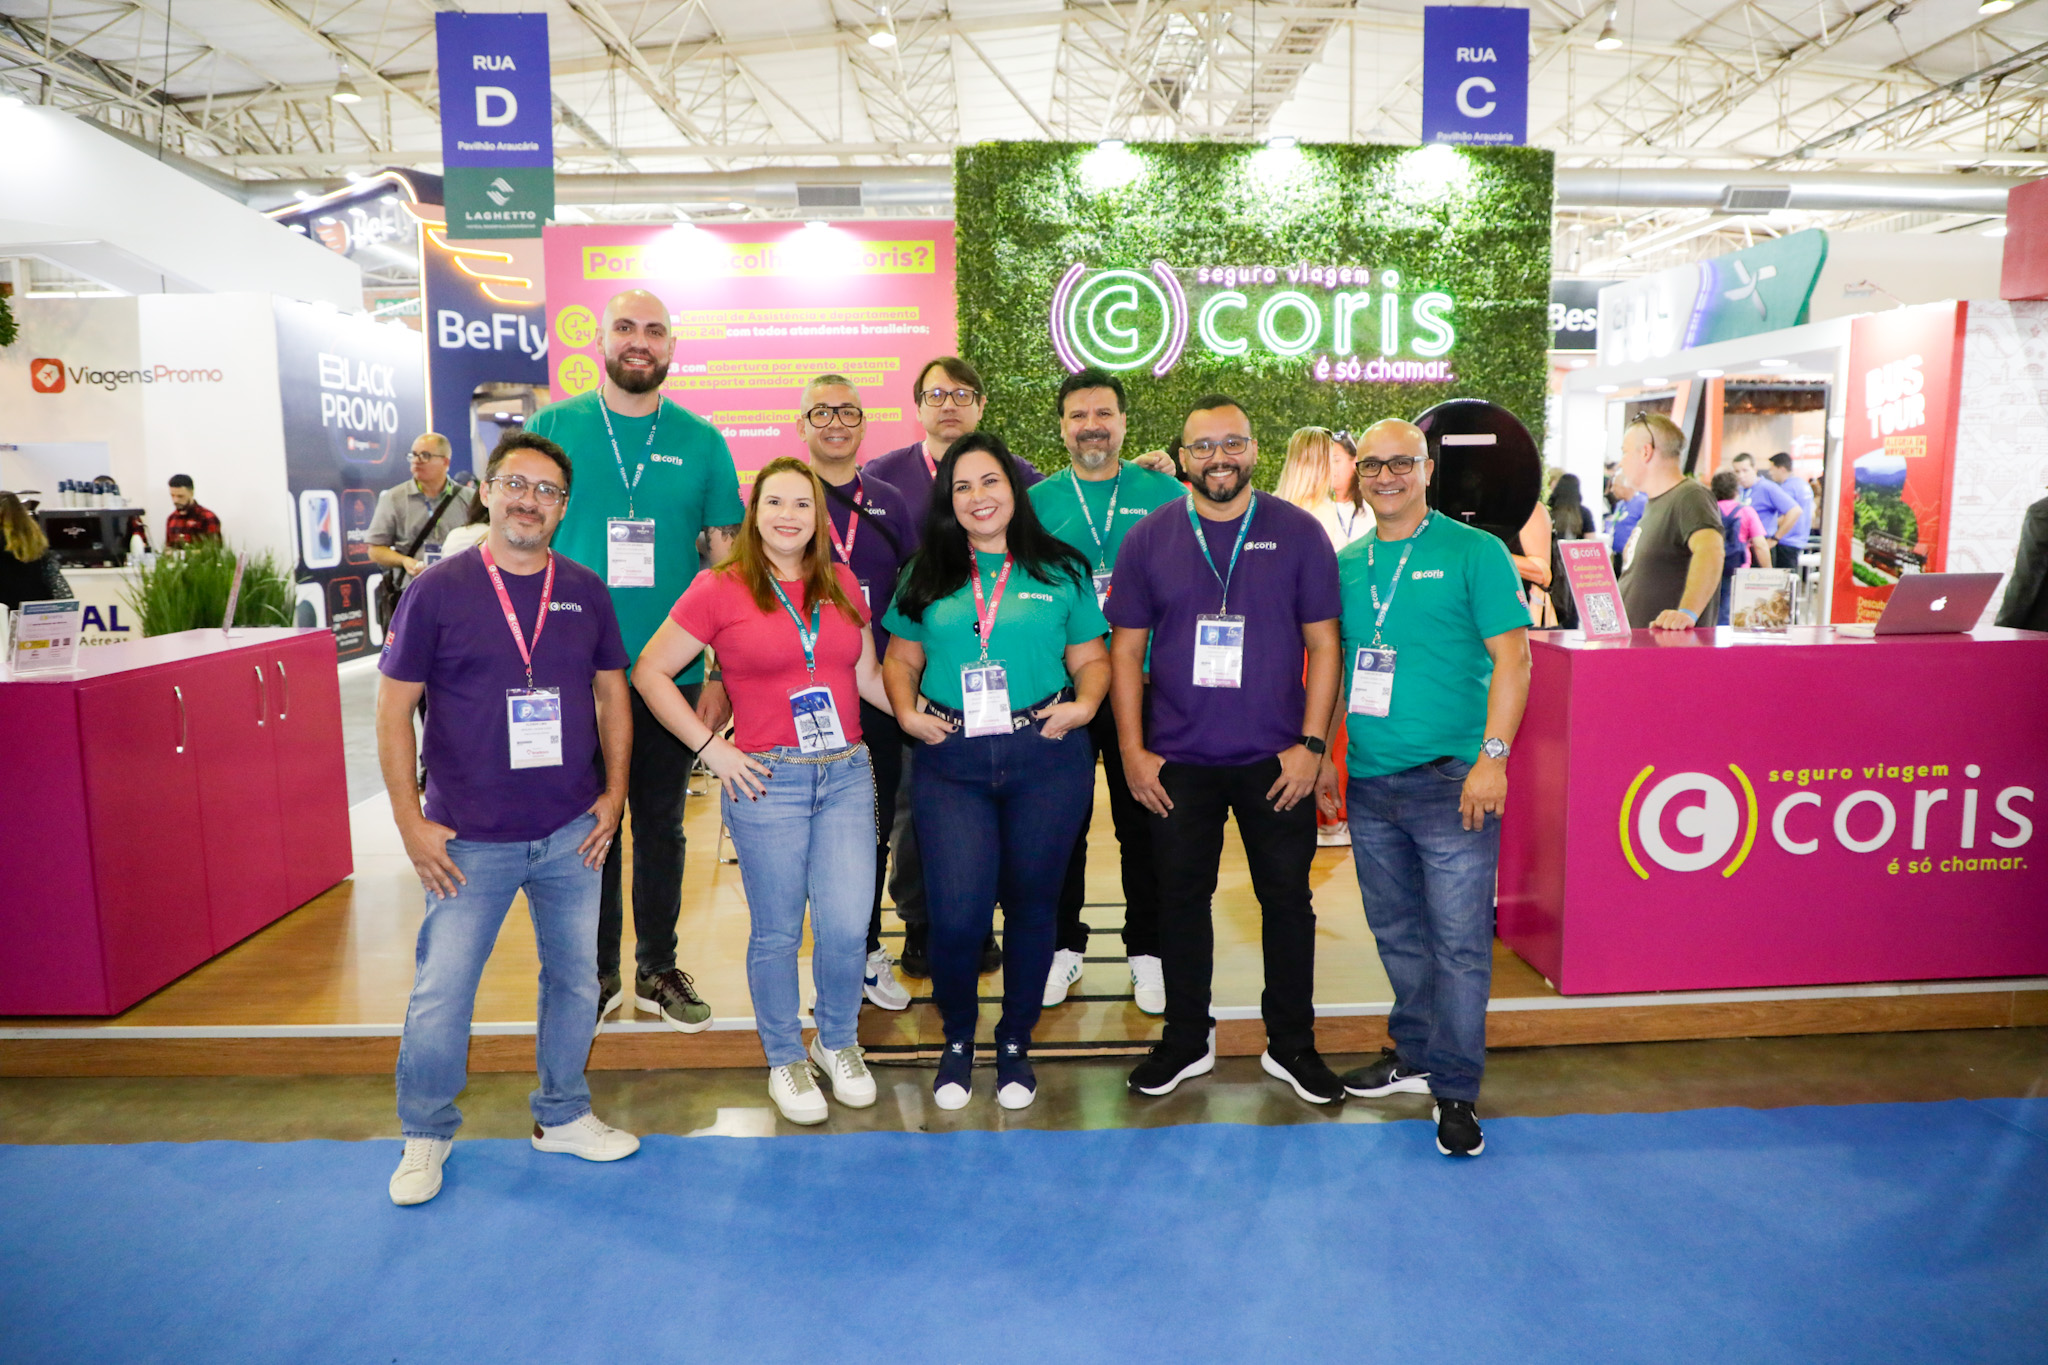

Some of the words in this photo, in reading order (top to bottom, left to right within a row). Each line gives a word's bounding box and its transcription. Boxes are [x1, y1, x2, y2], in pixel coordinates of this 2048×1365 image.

[1456, 47, 1498, 62] RUA
[472, 55, 517, 71] RUA
[1456, 76, 1497, 118] C
[475, 86, 518, 127] D
[1436, 131, 1473, 141] Pavilhão
[1473, 132, 1514, 141] Araucária
[457, 140, 496, 151] Pavilhão
[497, 141, 539, 151] Araucária
[465, 211, 536, 221] LAGHETTO
[589, 252, 636, 273] Por
[854, 246, 930, 267] oris?
[1198, 266, 1277, 289] seguro
[1287, 263, 1371, 290] viagem
[682, 312, 728, 323] Central
[731, 312, 745, 321] de
[748, 310, 817, 322] Assistência
[820, 312, 826, 320] e
[830, 308, 917, 321] departamento
[1198, 269, 1456, 357] coris
[437, 310, 548, 360] BeFly
[575, 330, 591, 341] 24
[700, 327, 724, 337] 24h
[726, 327, 751, 337] com
[752, 325, 788, 337] todos
[789, 324, 859, 336] atendentes
[861, 323, 930, 336] brasileiros;
[318, 352, 397, 398] BLACK
[681, 363, 707, 373] com
[709, 361, 769, 372] cobertura
[772, 362, 792, 373] por
[1316, 357, 1330, 378] é
[1335, 357, 1362, 379] só
[1366, 357, 1455, 379] chamar.
[68, 365, 223, 391] ViagensPromo
[662, 376, 687, 390] gico
[690, 379, 697, 387] e
[699, 376, 746, 389] esporte
[748, 375, 795, 386] amador
[797, 377, 805, 385] e
[1865, 354, 1924, 409] BUS
[320, 392, 398, 434] PROMO
[714, 411, 790, 423] telemedicina
[793, 413, 800, 421] e
[1866, 393, 1925, 439] TOUR
[722, 427, 737, 437] do
[739, 426, 780, 438] mundo
[661, 455, 683, 466] coris
[632, 470, 642, 487] coris
[868, 508, 887, 516] coris
[1128, 507, 1148, 516] coris
[1412, 524, 1426, 538] coris
[1254, 541, 1277, 550] coris
[1580, 546, 1601, 557] coris
[492, 571, 505, 591] coris
[999, 567, 1010, 583] coris
[1392, 564, 1405, 582] coris
[1422, 569, 1444, 579] coris
[973, 576, 982, 593] coris
[1030, 592, 1053, 602] coris
[1858, 596, 1887, 608] Descub
[560, 602, 582, 612] coris
[81, 605, 130, 633] AL
[536, 602, 547, 629] CONFIANÇA
[985, 607, 997, 625] coris
[510, 620, 522, 641] coris
[1768, 765, 1853, 786] seguro
[1863, 762, 1950, 784] viagem
[1771, 763, 2035, 855] coris
[1887, 857, 1900, 875] é
[1908, 855, 1932, 874] só
[1940, 855, 2028, 873] chamar.
